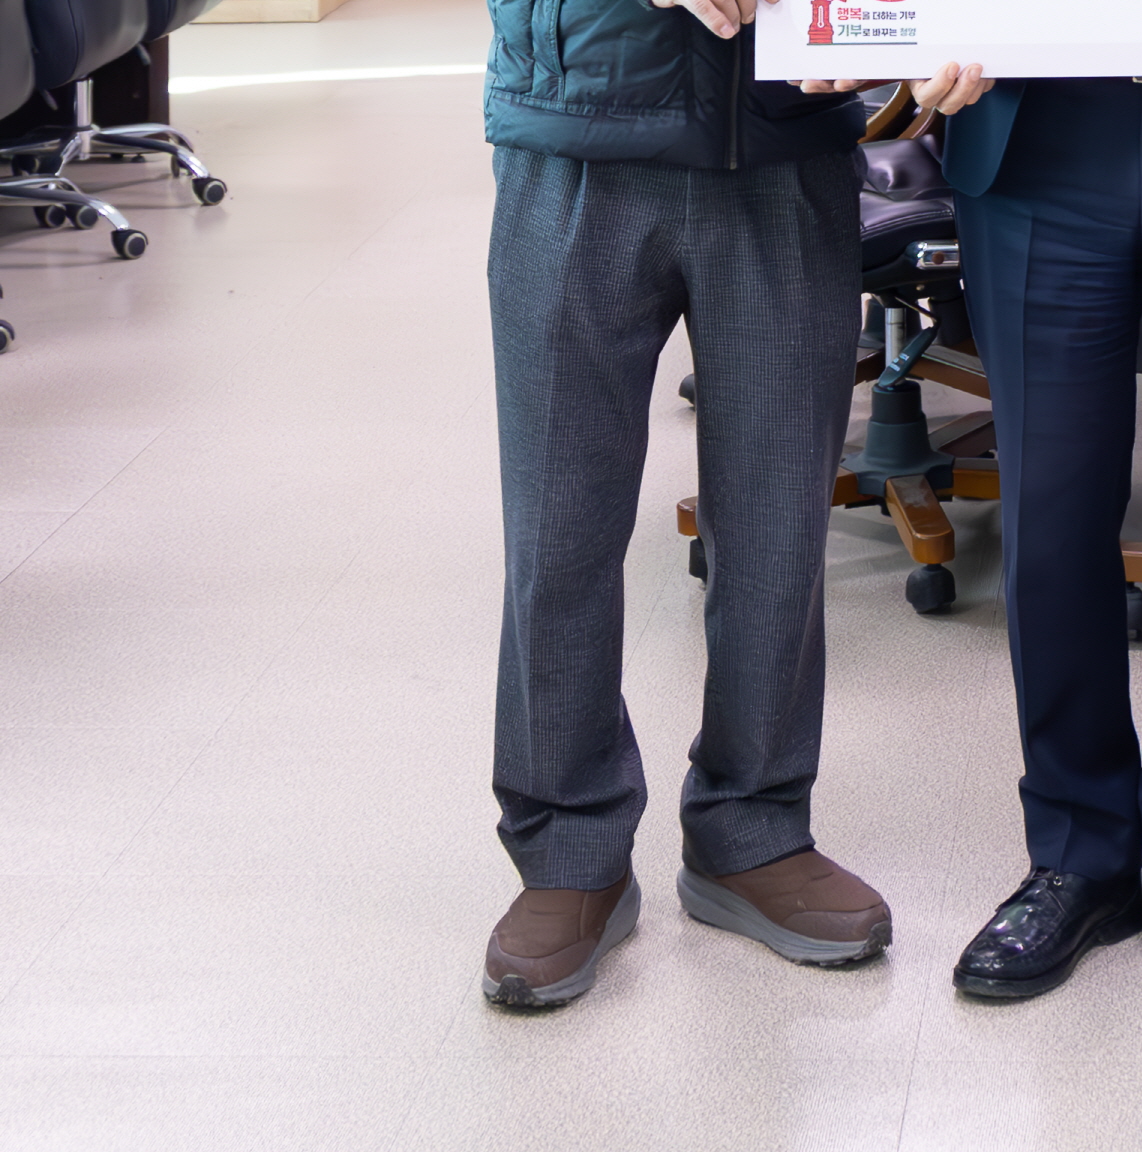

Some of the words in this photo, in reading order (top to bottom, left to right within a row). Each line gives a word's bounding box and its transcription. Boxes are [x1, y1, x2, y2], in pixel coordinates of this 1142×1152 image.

[837, 7, 870, 21] 행복을
[872, 11, 897, 20] 더하는
[899, 11, 916, 20] 기부
[837, 24, 870, 37] 기부로
[872, 28, 897, 36] 바꾸는
